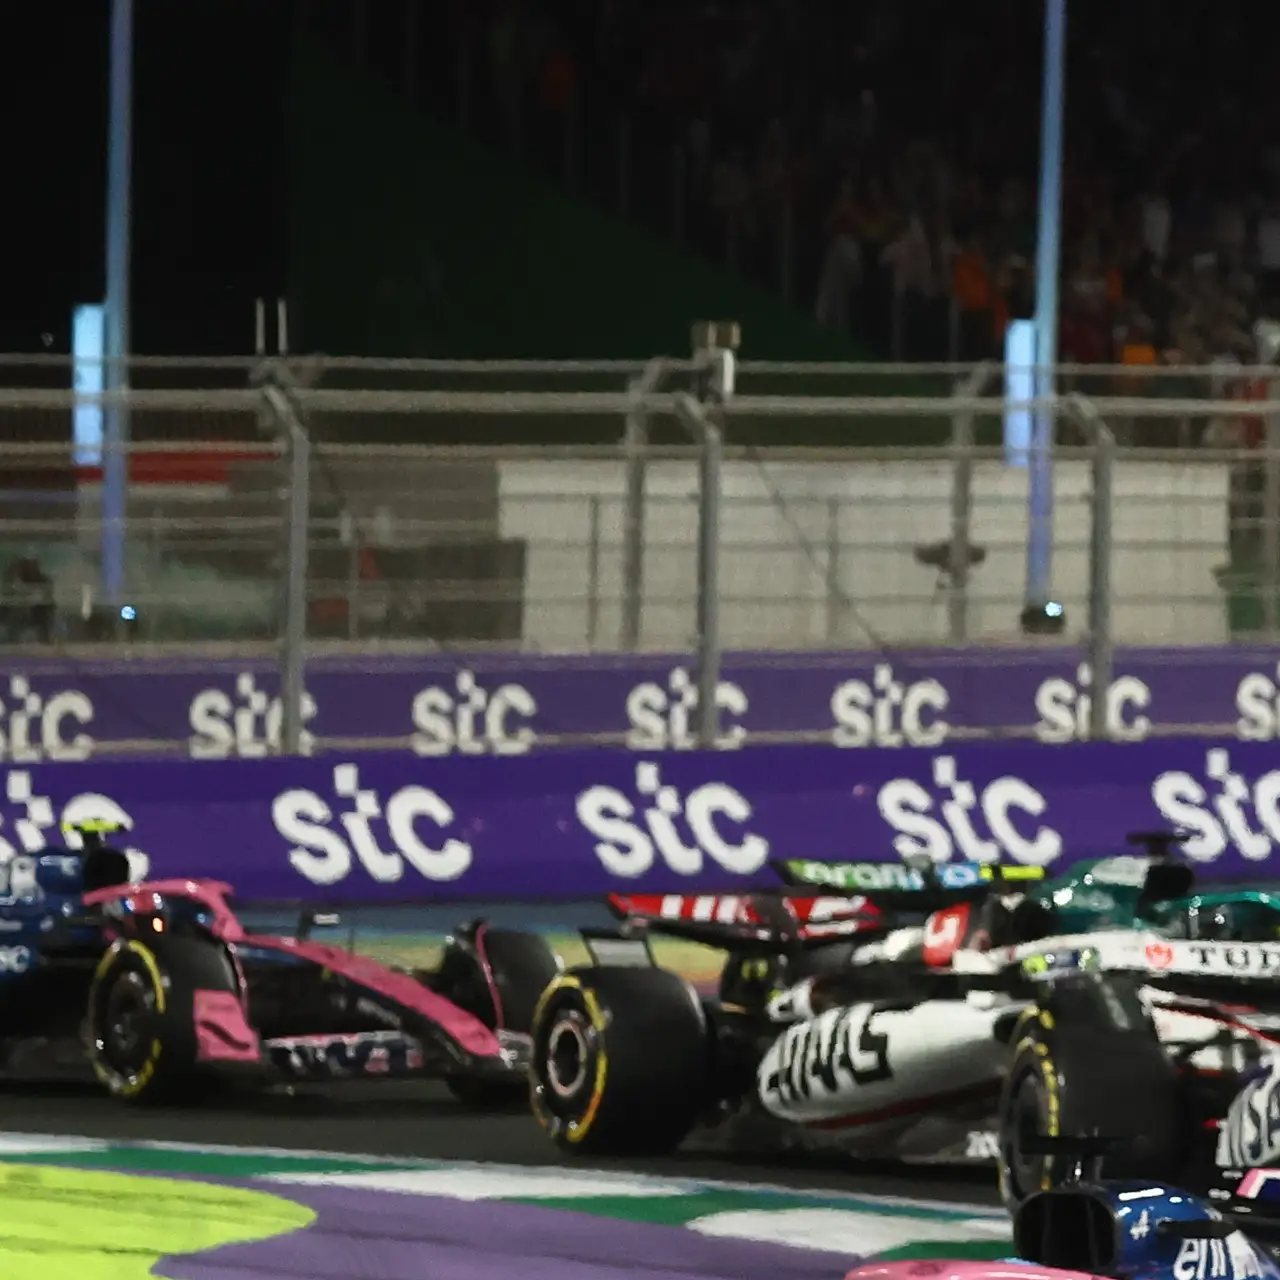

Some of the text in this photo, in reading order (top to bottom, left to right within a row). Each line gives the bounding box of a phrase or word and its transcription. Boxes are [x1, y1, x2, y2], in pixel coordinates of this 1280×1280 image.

[412, 667, 537, 756] stc
[626, 665, 749, 753] stc
[831, 662, 950, 748] stc
[272, 762, 472, 884] stc
[575, 760, 768, 878] stc
[876, 754, 1063, 866] stc
